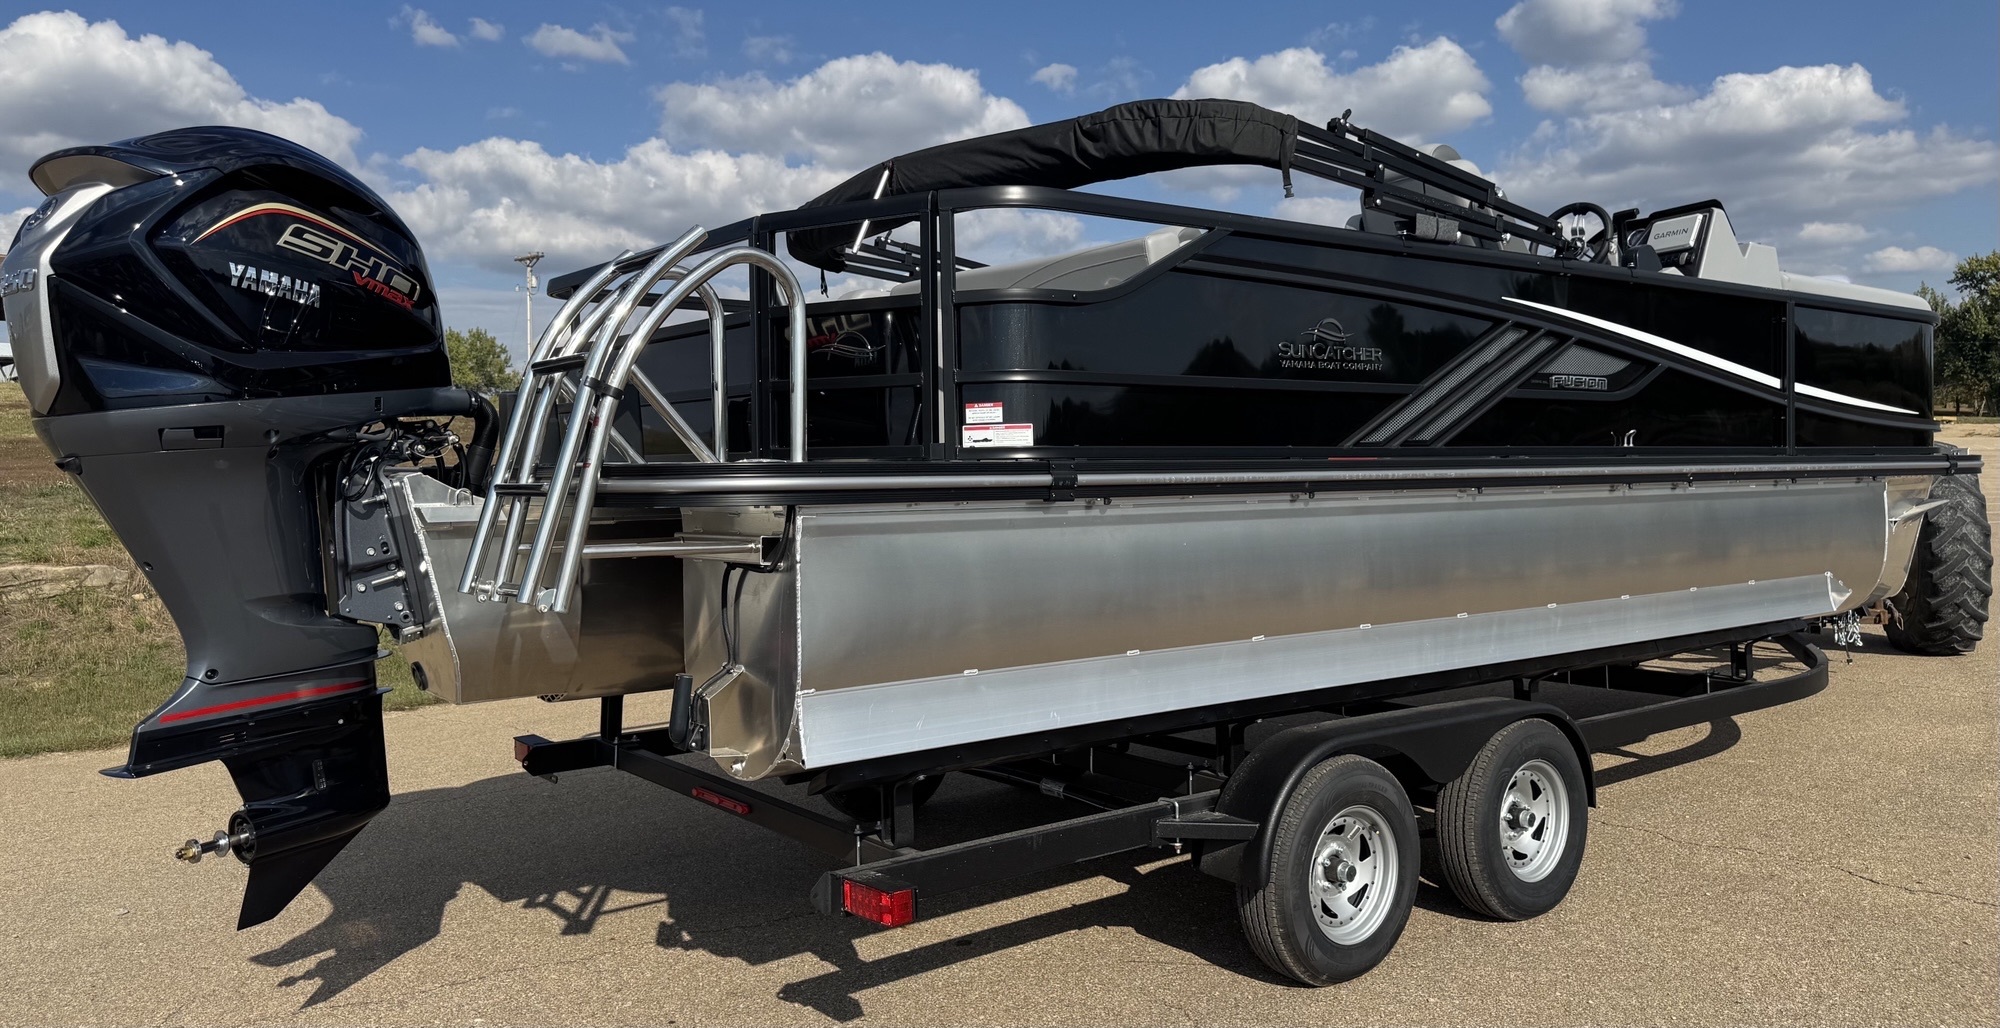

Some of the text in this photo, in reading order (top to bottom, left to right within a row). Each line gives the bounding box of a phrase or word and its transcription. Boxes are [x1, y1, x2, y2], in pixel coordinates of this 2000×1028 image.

[1653, 228, 1689, 240] GARMIN
[276, 223, 421, 301] SHO
[229, 262, 321, 308] YAMAHA
[1280, 360, 1383, 371] YAMAHA BOAT COMPANY
[1549, 375, 1607, 390] FUSION
